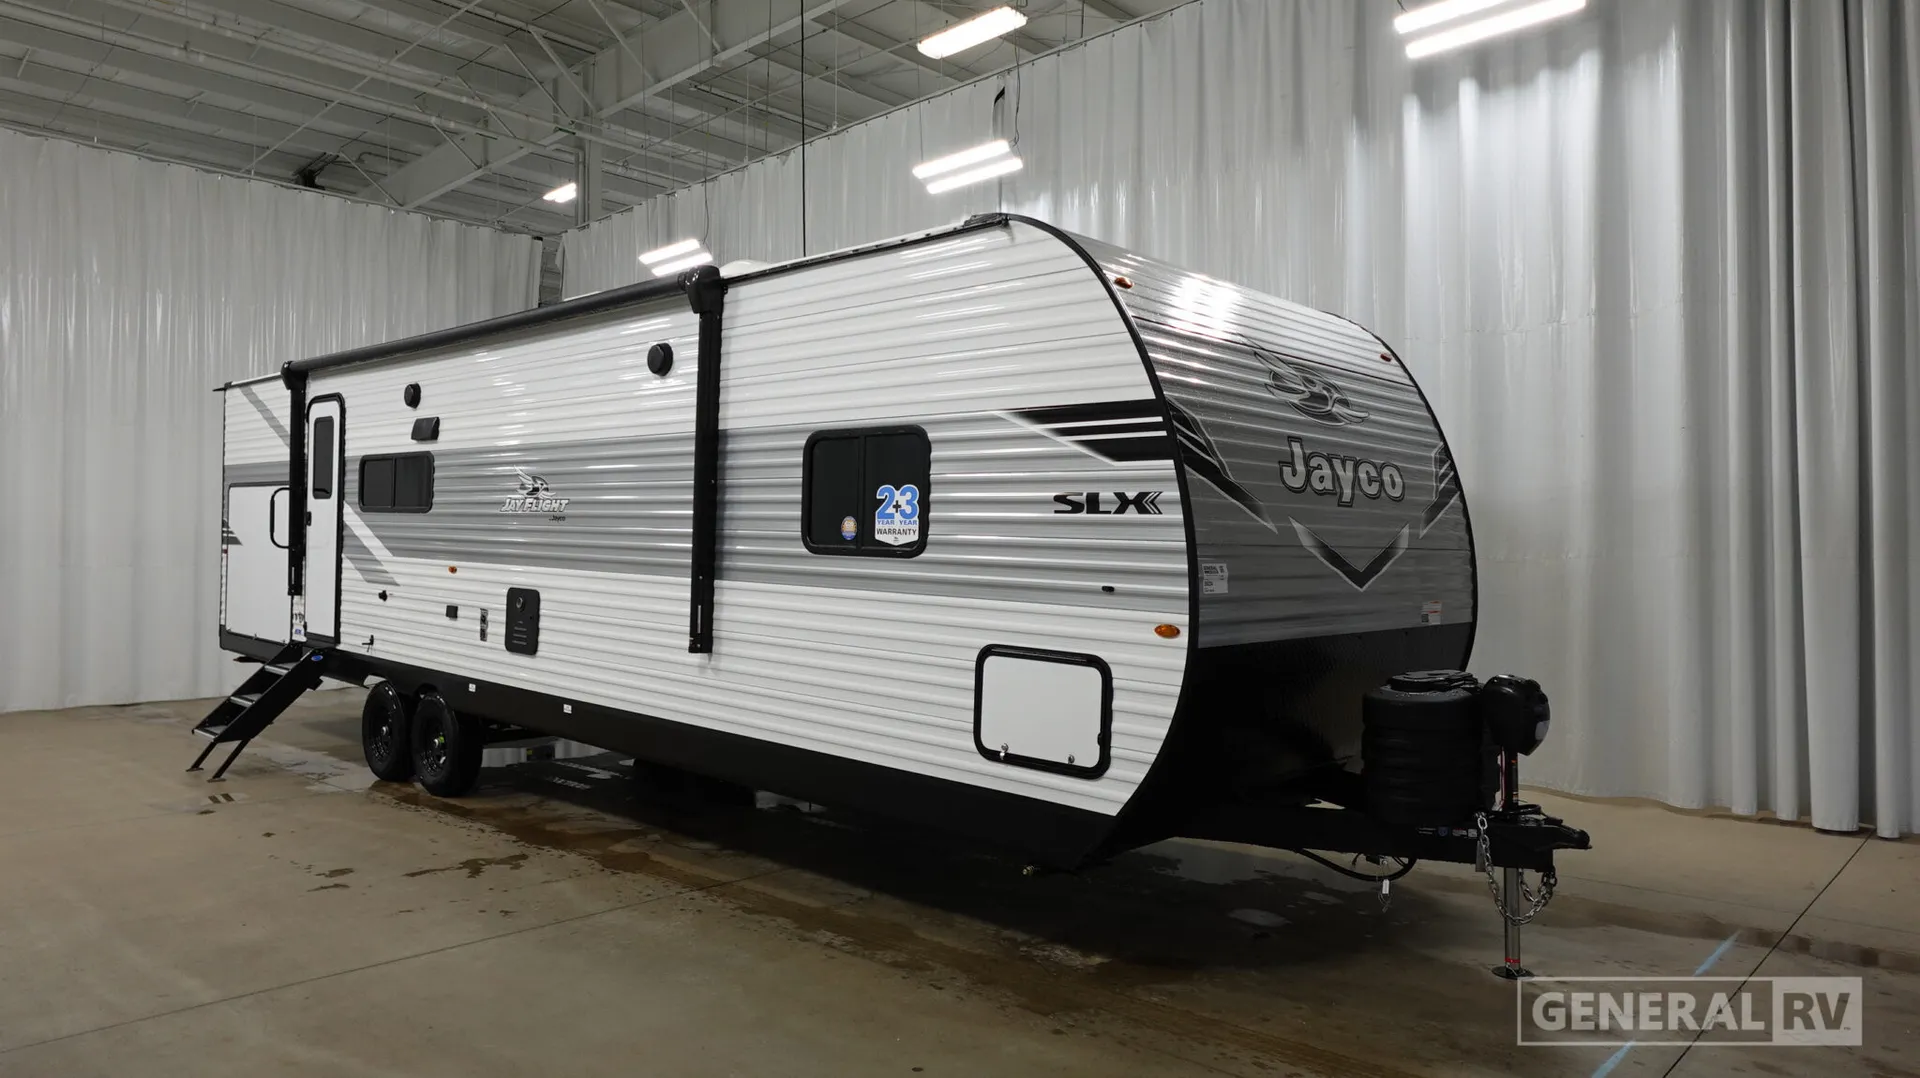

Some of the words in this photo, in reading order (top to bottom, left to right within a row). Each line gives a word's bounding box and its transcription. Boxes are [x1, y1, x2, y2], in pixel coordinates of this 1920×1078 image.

[1278, 436, 1406, 508] Jayco
[1053, 491, 1163, 515] SLX
[876, 528, 917, 536] WARRANTY
